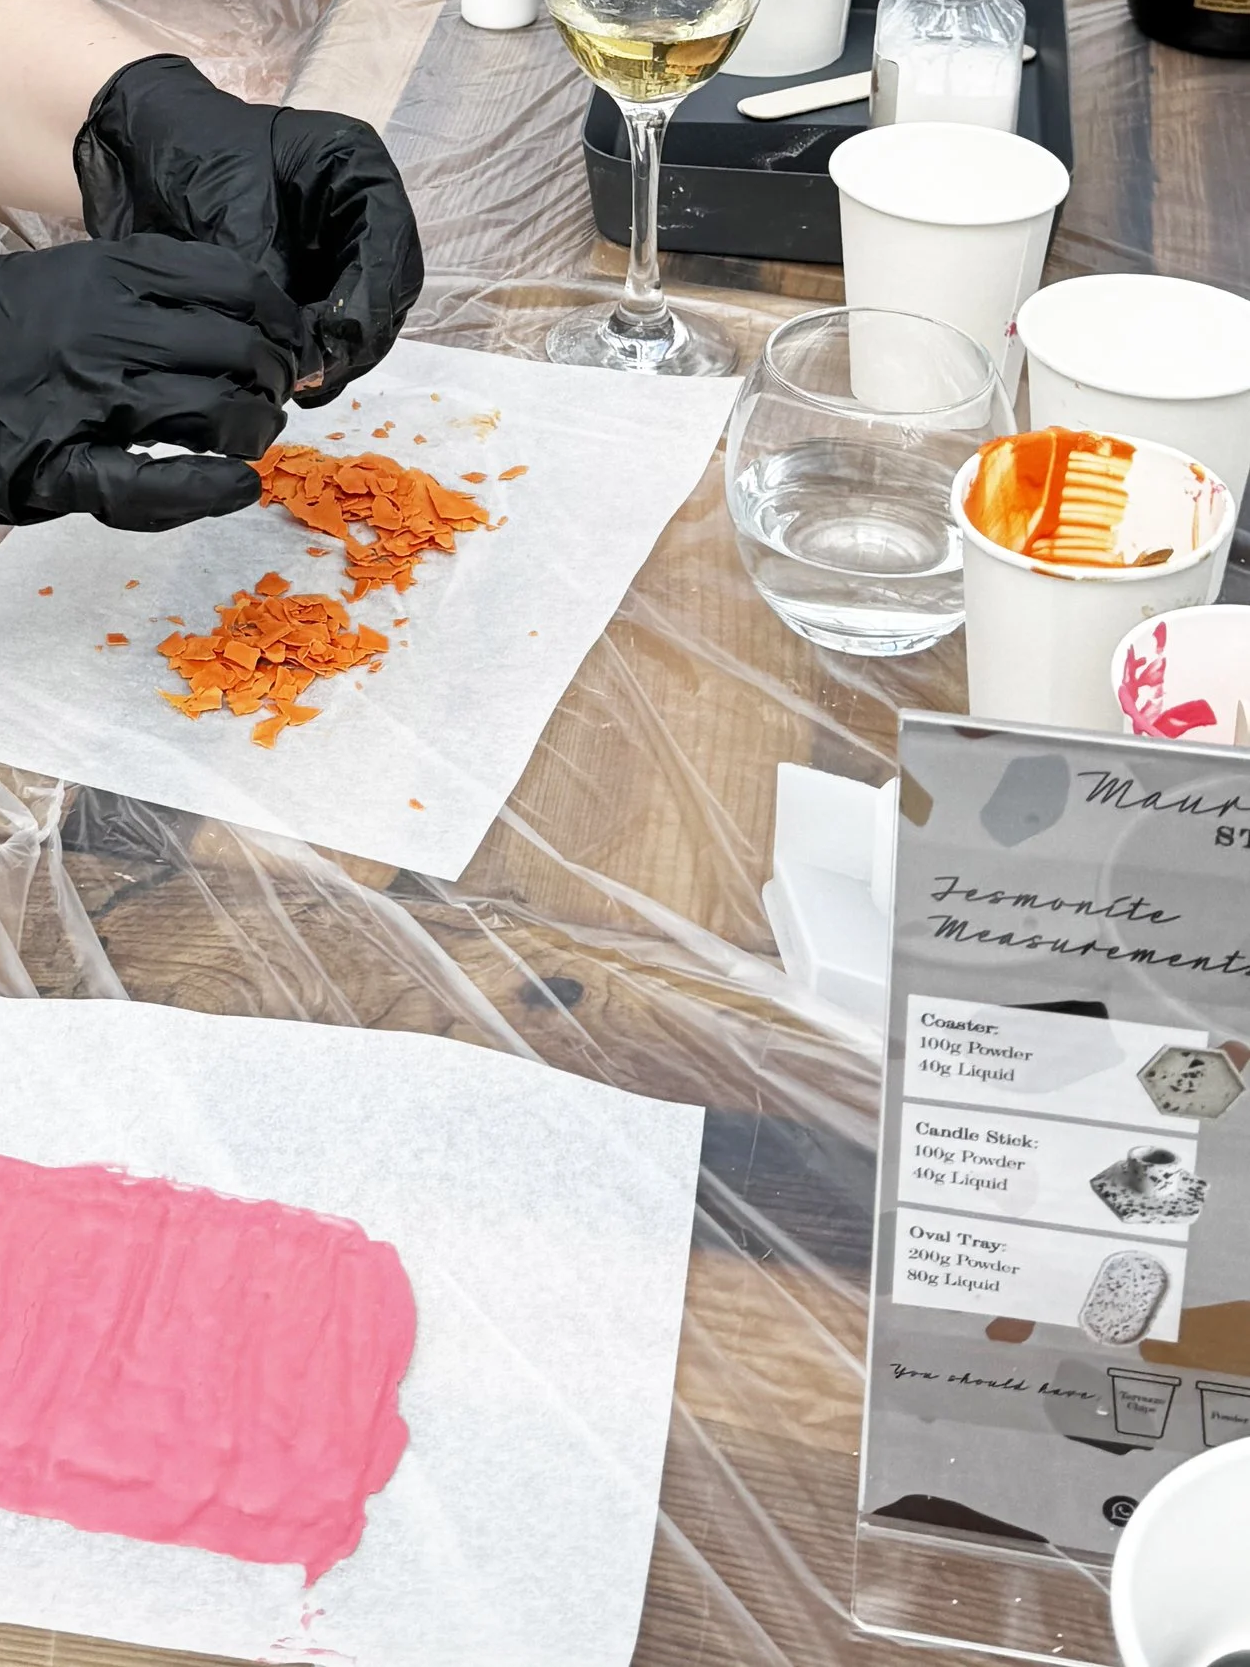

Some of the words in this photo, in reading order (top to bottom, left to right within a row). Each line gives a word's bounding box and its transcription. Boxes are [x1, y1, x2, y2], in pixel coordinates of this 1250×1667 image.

[931, 876, 1181, 924] Jesmonite
[920, 1036, 962, 1056] 100g
[968, 1041, 1034, 1061] Powder
[918, 1059, 952, 1077] 40g
[958, 1062, 1015, 1082] Liquid
[915, 1121, 979, 1141] Candle
[986, 1130, 1039, 1149] Stick:
[914, 1144, 955, 1164] 100g
[961, 1150, 1026, 1170] Powder
[913, 1167, 946, 1184] 40g
[951, 1171, 1008, 1191] Liquid
[909, 1225, 950, 1243] Oval
[956, 1232, 1007, 1253] Tray:
[908, 1248, 951, 1267] 200g
[956, 1254, 1021, 1274] Powder
[907, 1269, 940, 1286] 80g
[944, 1273, 1000, 1292] Liquid
[890, 1363, 940, 1379] You
[947, 1373, 1030, 1391] should
